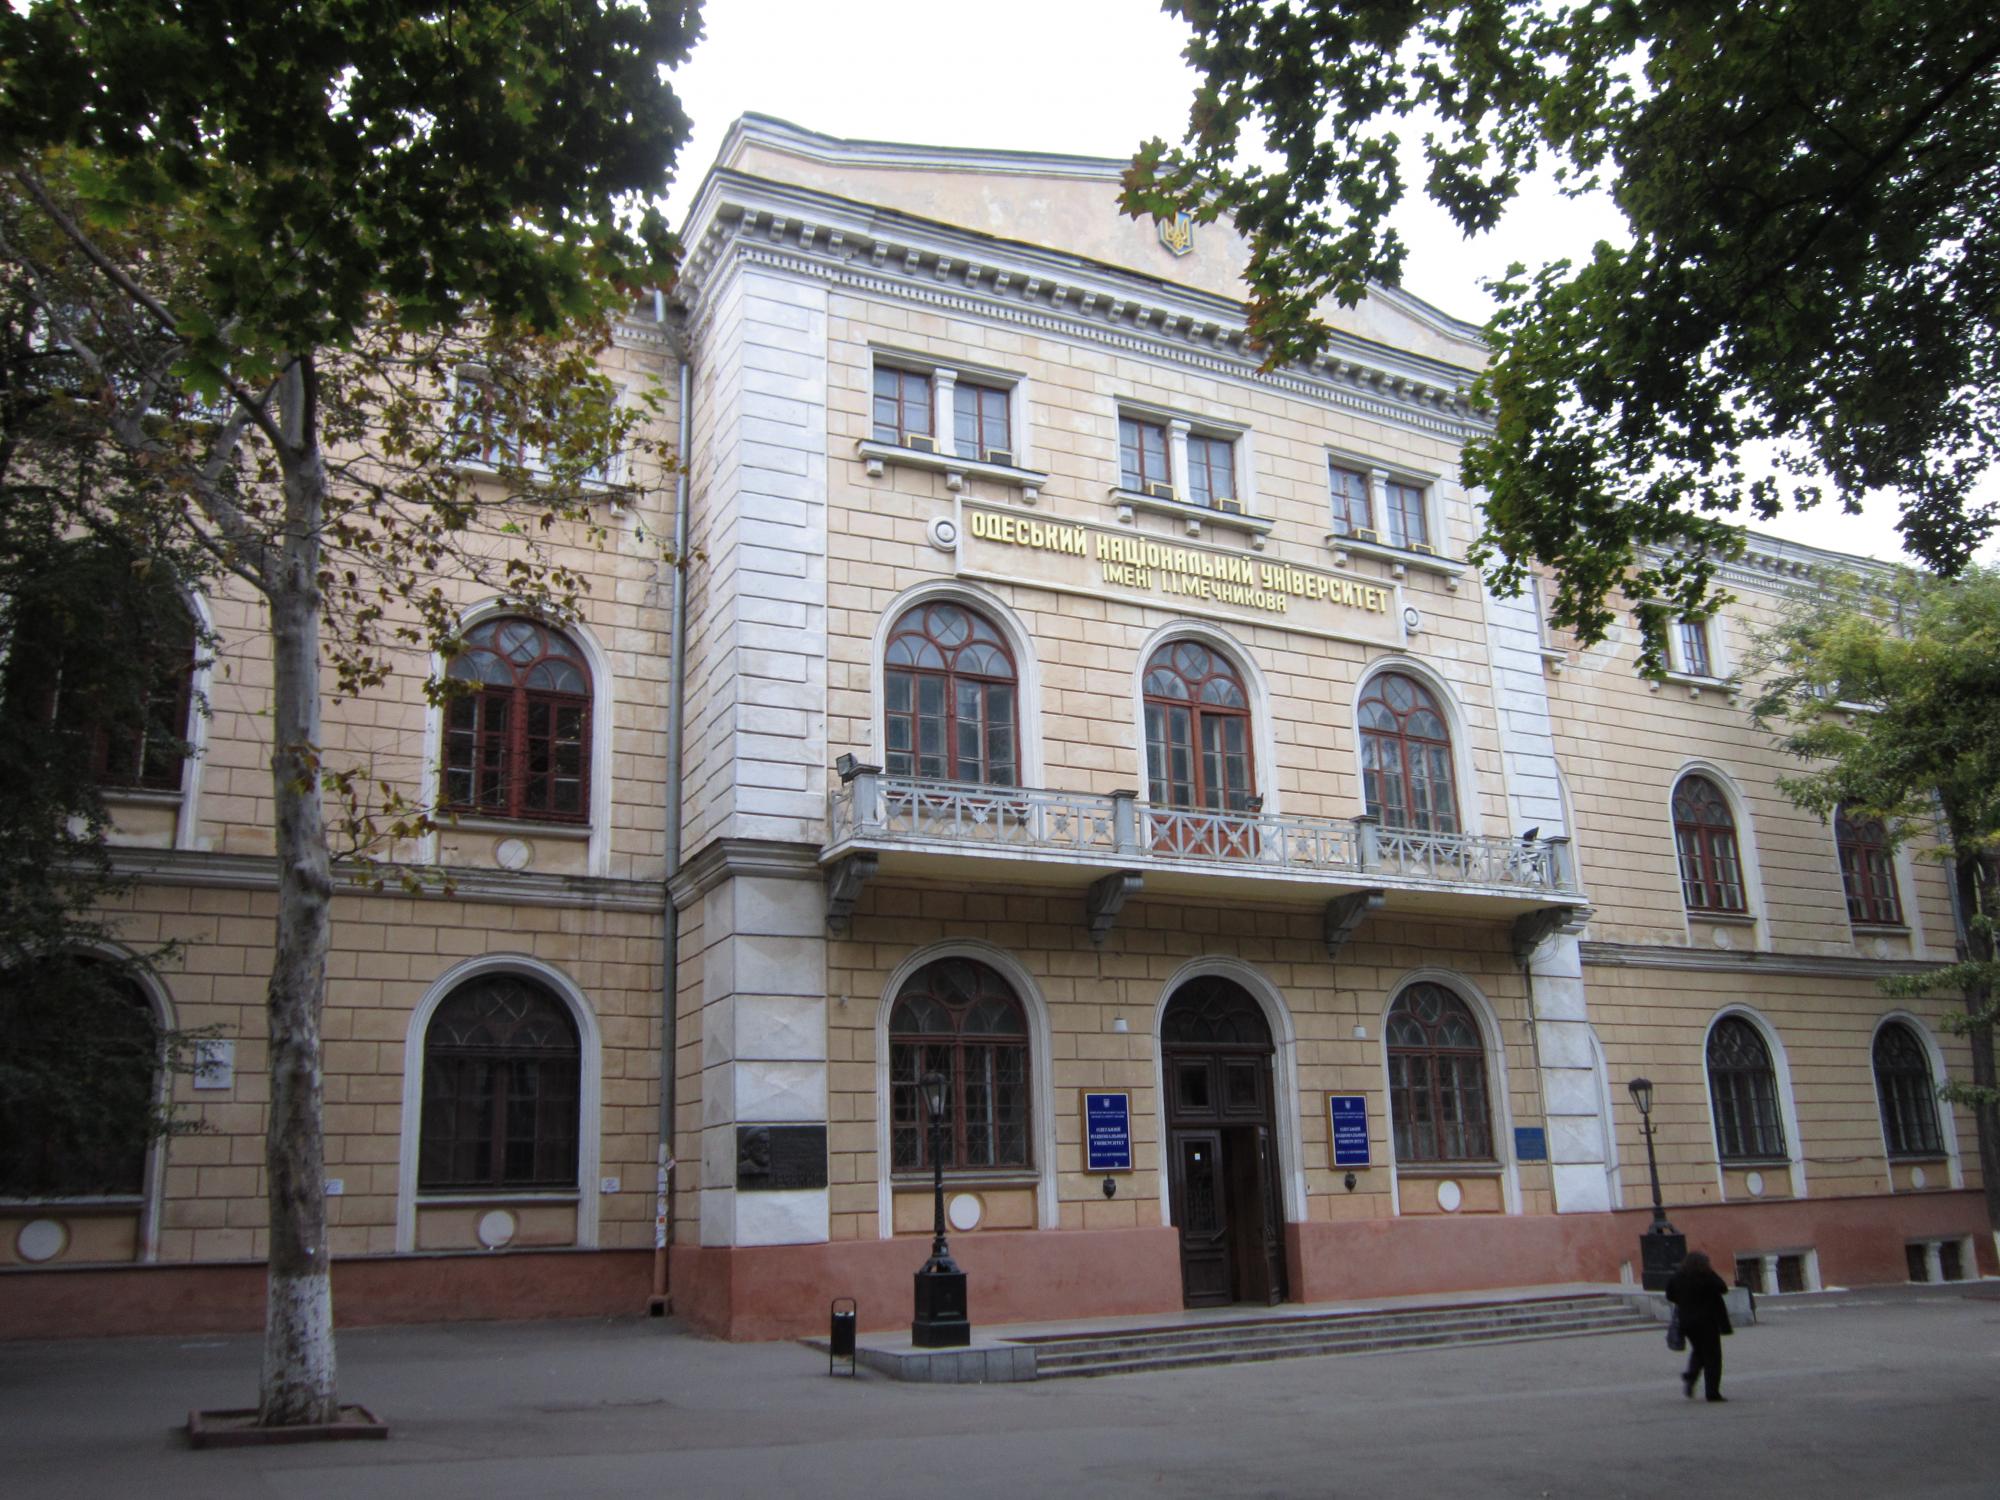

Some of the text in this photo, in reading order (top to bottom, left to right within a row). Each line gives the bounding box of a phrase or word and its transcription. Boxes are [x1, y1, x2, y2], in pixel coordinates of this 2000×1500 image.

[971, 511, 1387, 613] ОДЕСЬКИЙ НАЦІОНАЛЬНИЙ УНІВЕРСИТЕТ
